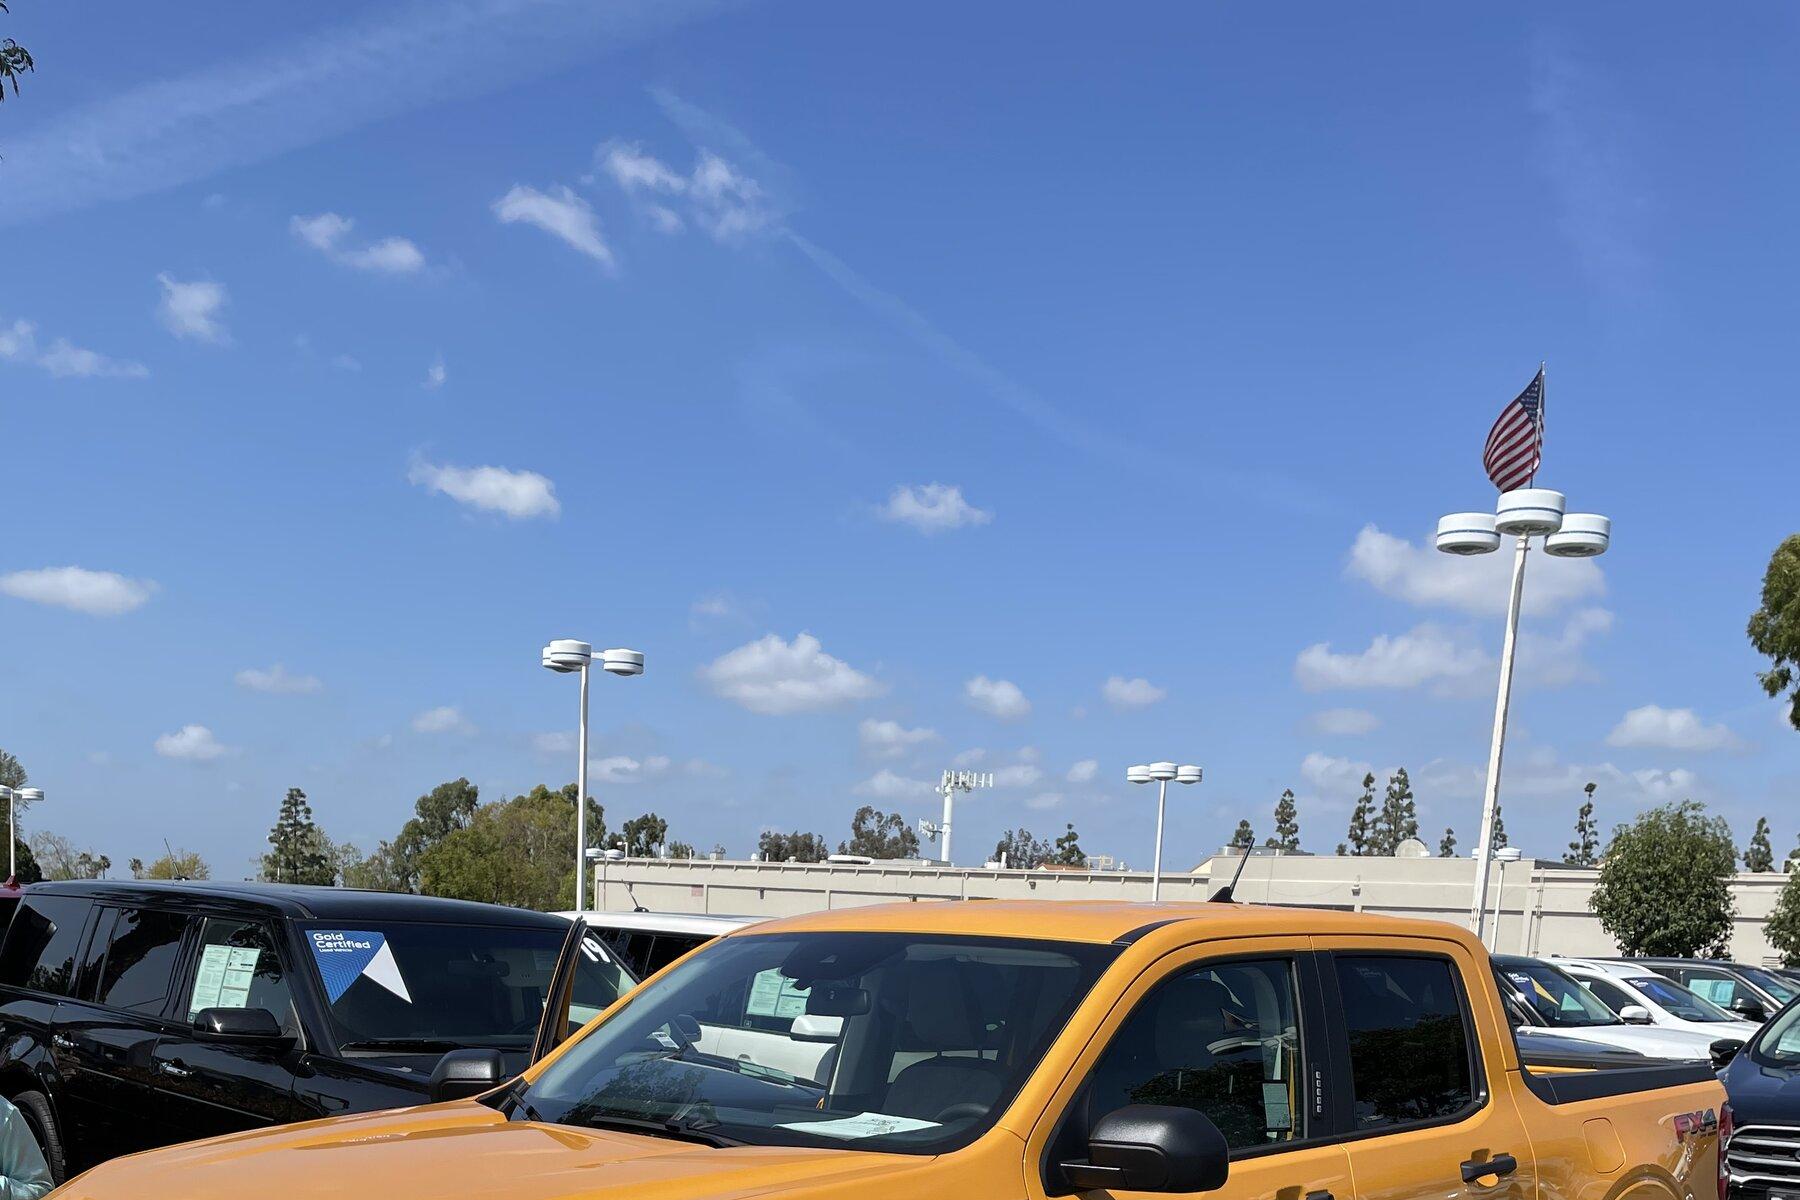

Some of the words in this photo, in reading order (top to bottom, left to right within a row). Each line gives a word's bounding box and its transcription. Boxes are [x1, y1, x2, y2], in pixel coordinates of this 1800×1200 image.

[313, 932, 344, 941] Gold
[316, 940, 371, 949] Certified
[1673, 1108, 1718, 1144] FX4
